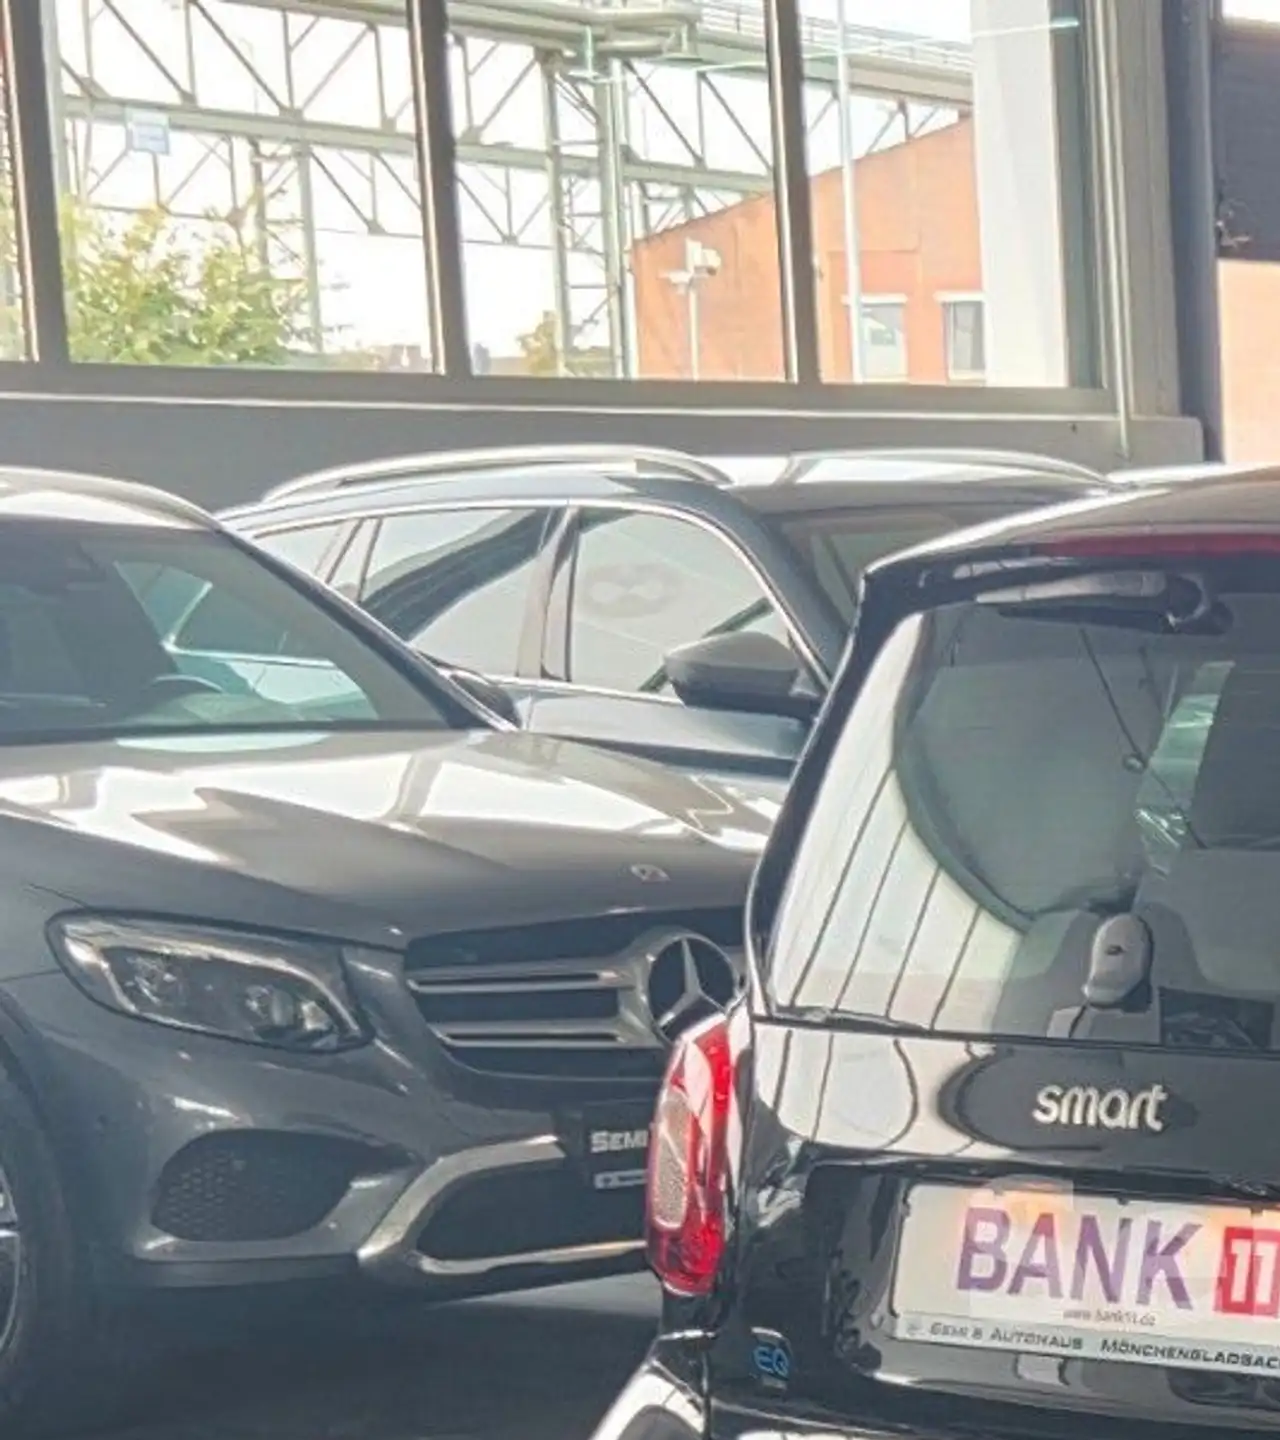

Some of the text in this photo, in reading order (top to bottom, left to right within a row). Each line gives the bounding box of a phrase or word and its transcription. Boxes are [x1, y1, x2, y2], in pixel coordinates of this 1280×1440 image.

[1032, 1084, 1169, 1131] smart
[956, 1206, 1280, 1310] BANK 11
